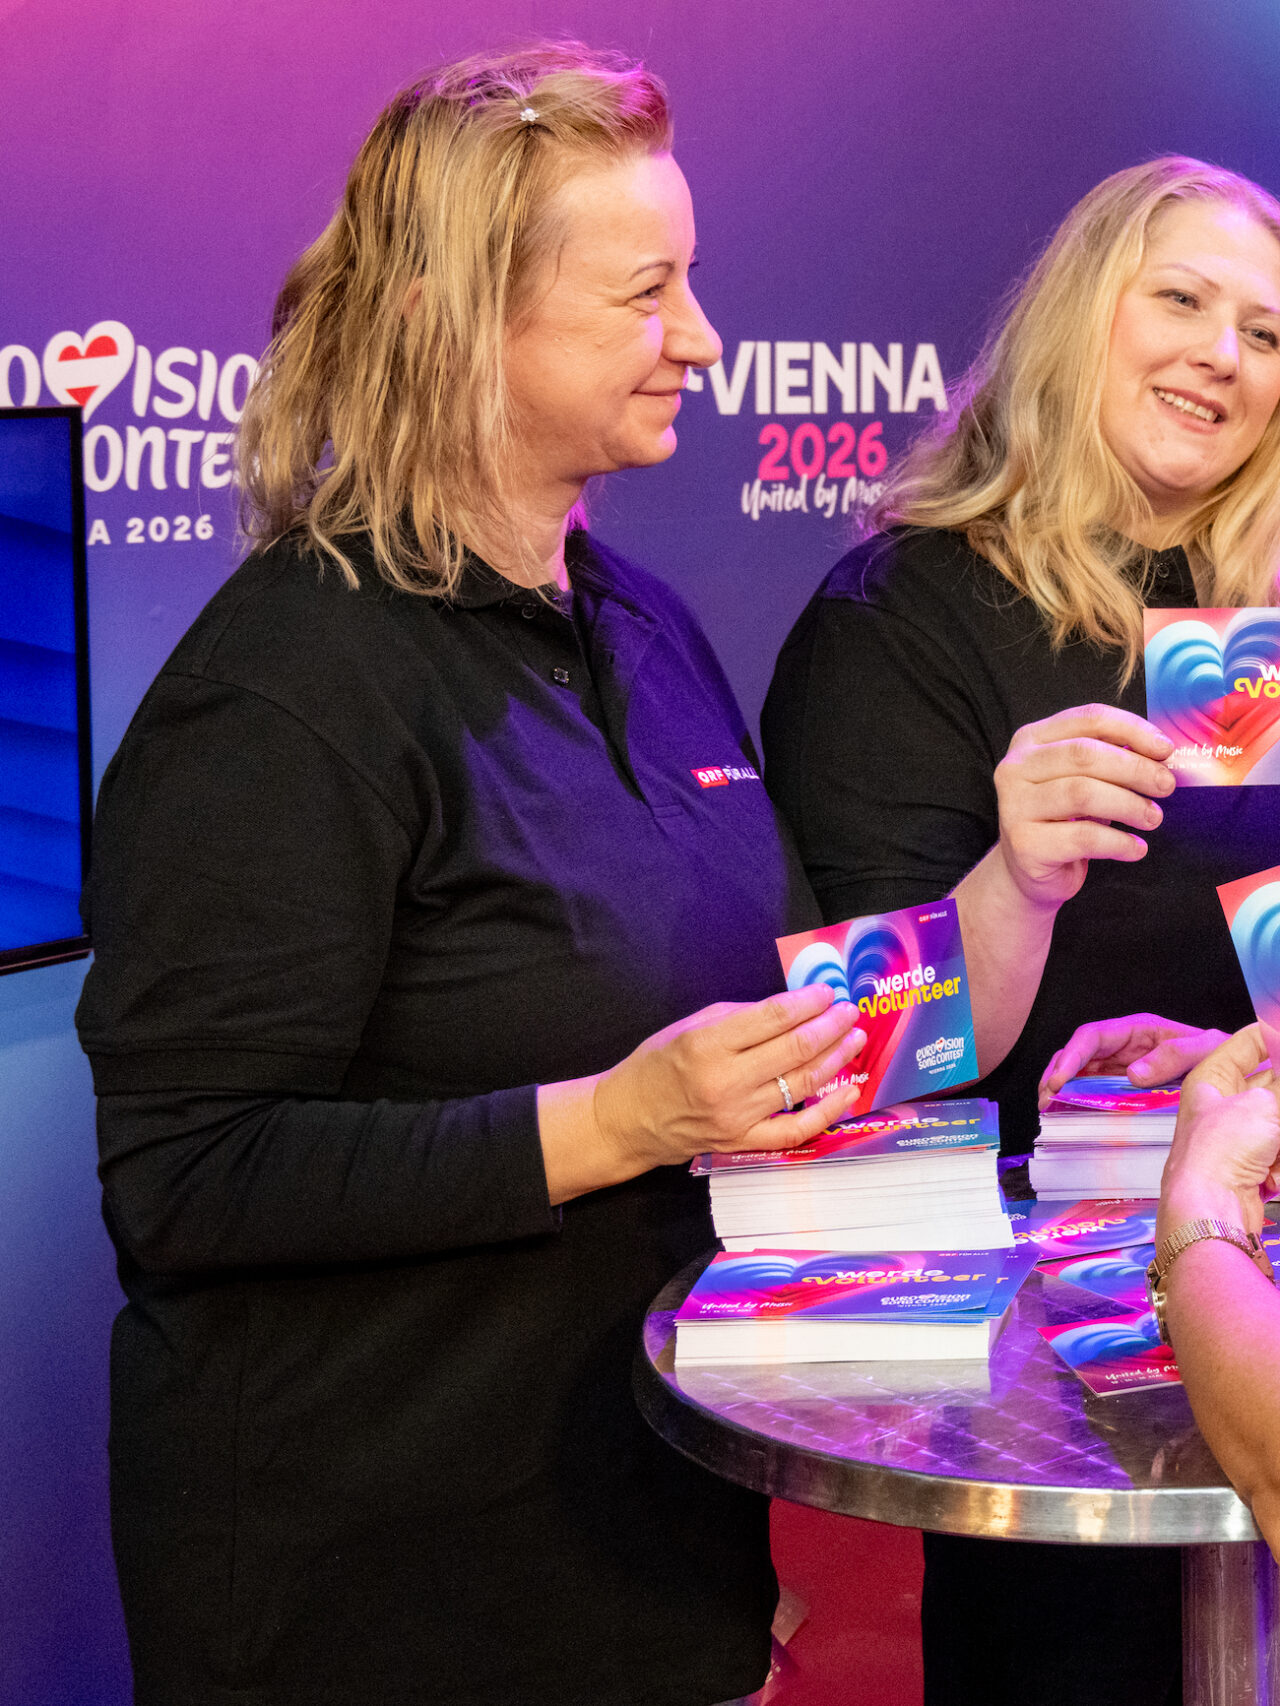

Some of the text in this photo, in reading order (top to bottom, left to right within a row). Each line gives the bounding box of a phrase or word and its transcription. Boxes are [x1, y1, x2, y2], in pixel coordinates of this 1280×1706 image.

[685, 341, 949, 416] VIENNA
[83, 424, 236, 492] ONTE
[758, 421, 888, 481] 2026
[741, 474, 808, 521] United
[814, 473, 838, 518] by
[126, 514, 214, 544] 2026
[1201, 743, 1213, 759] by
[1215, 744, 1243, 758] Music
[697, 769, 725, 784] ORF
[873, 964, 936, 997] werde
[858, 976, 961, 1018] Volunteer
[936, 1048, 963, 1064] CONTEST
[823, 1118, 980, 1136] Volunteer
[839, 1116, 940, 1130] werde
[801, 1273, 986, 1285] Volunteer
[835, 1268, 945, 1279] werde
